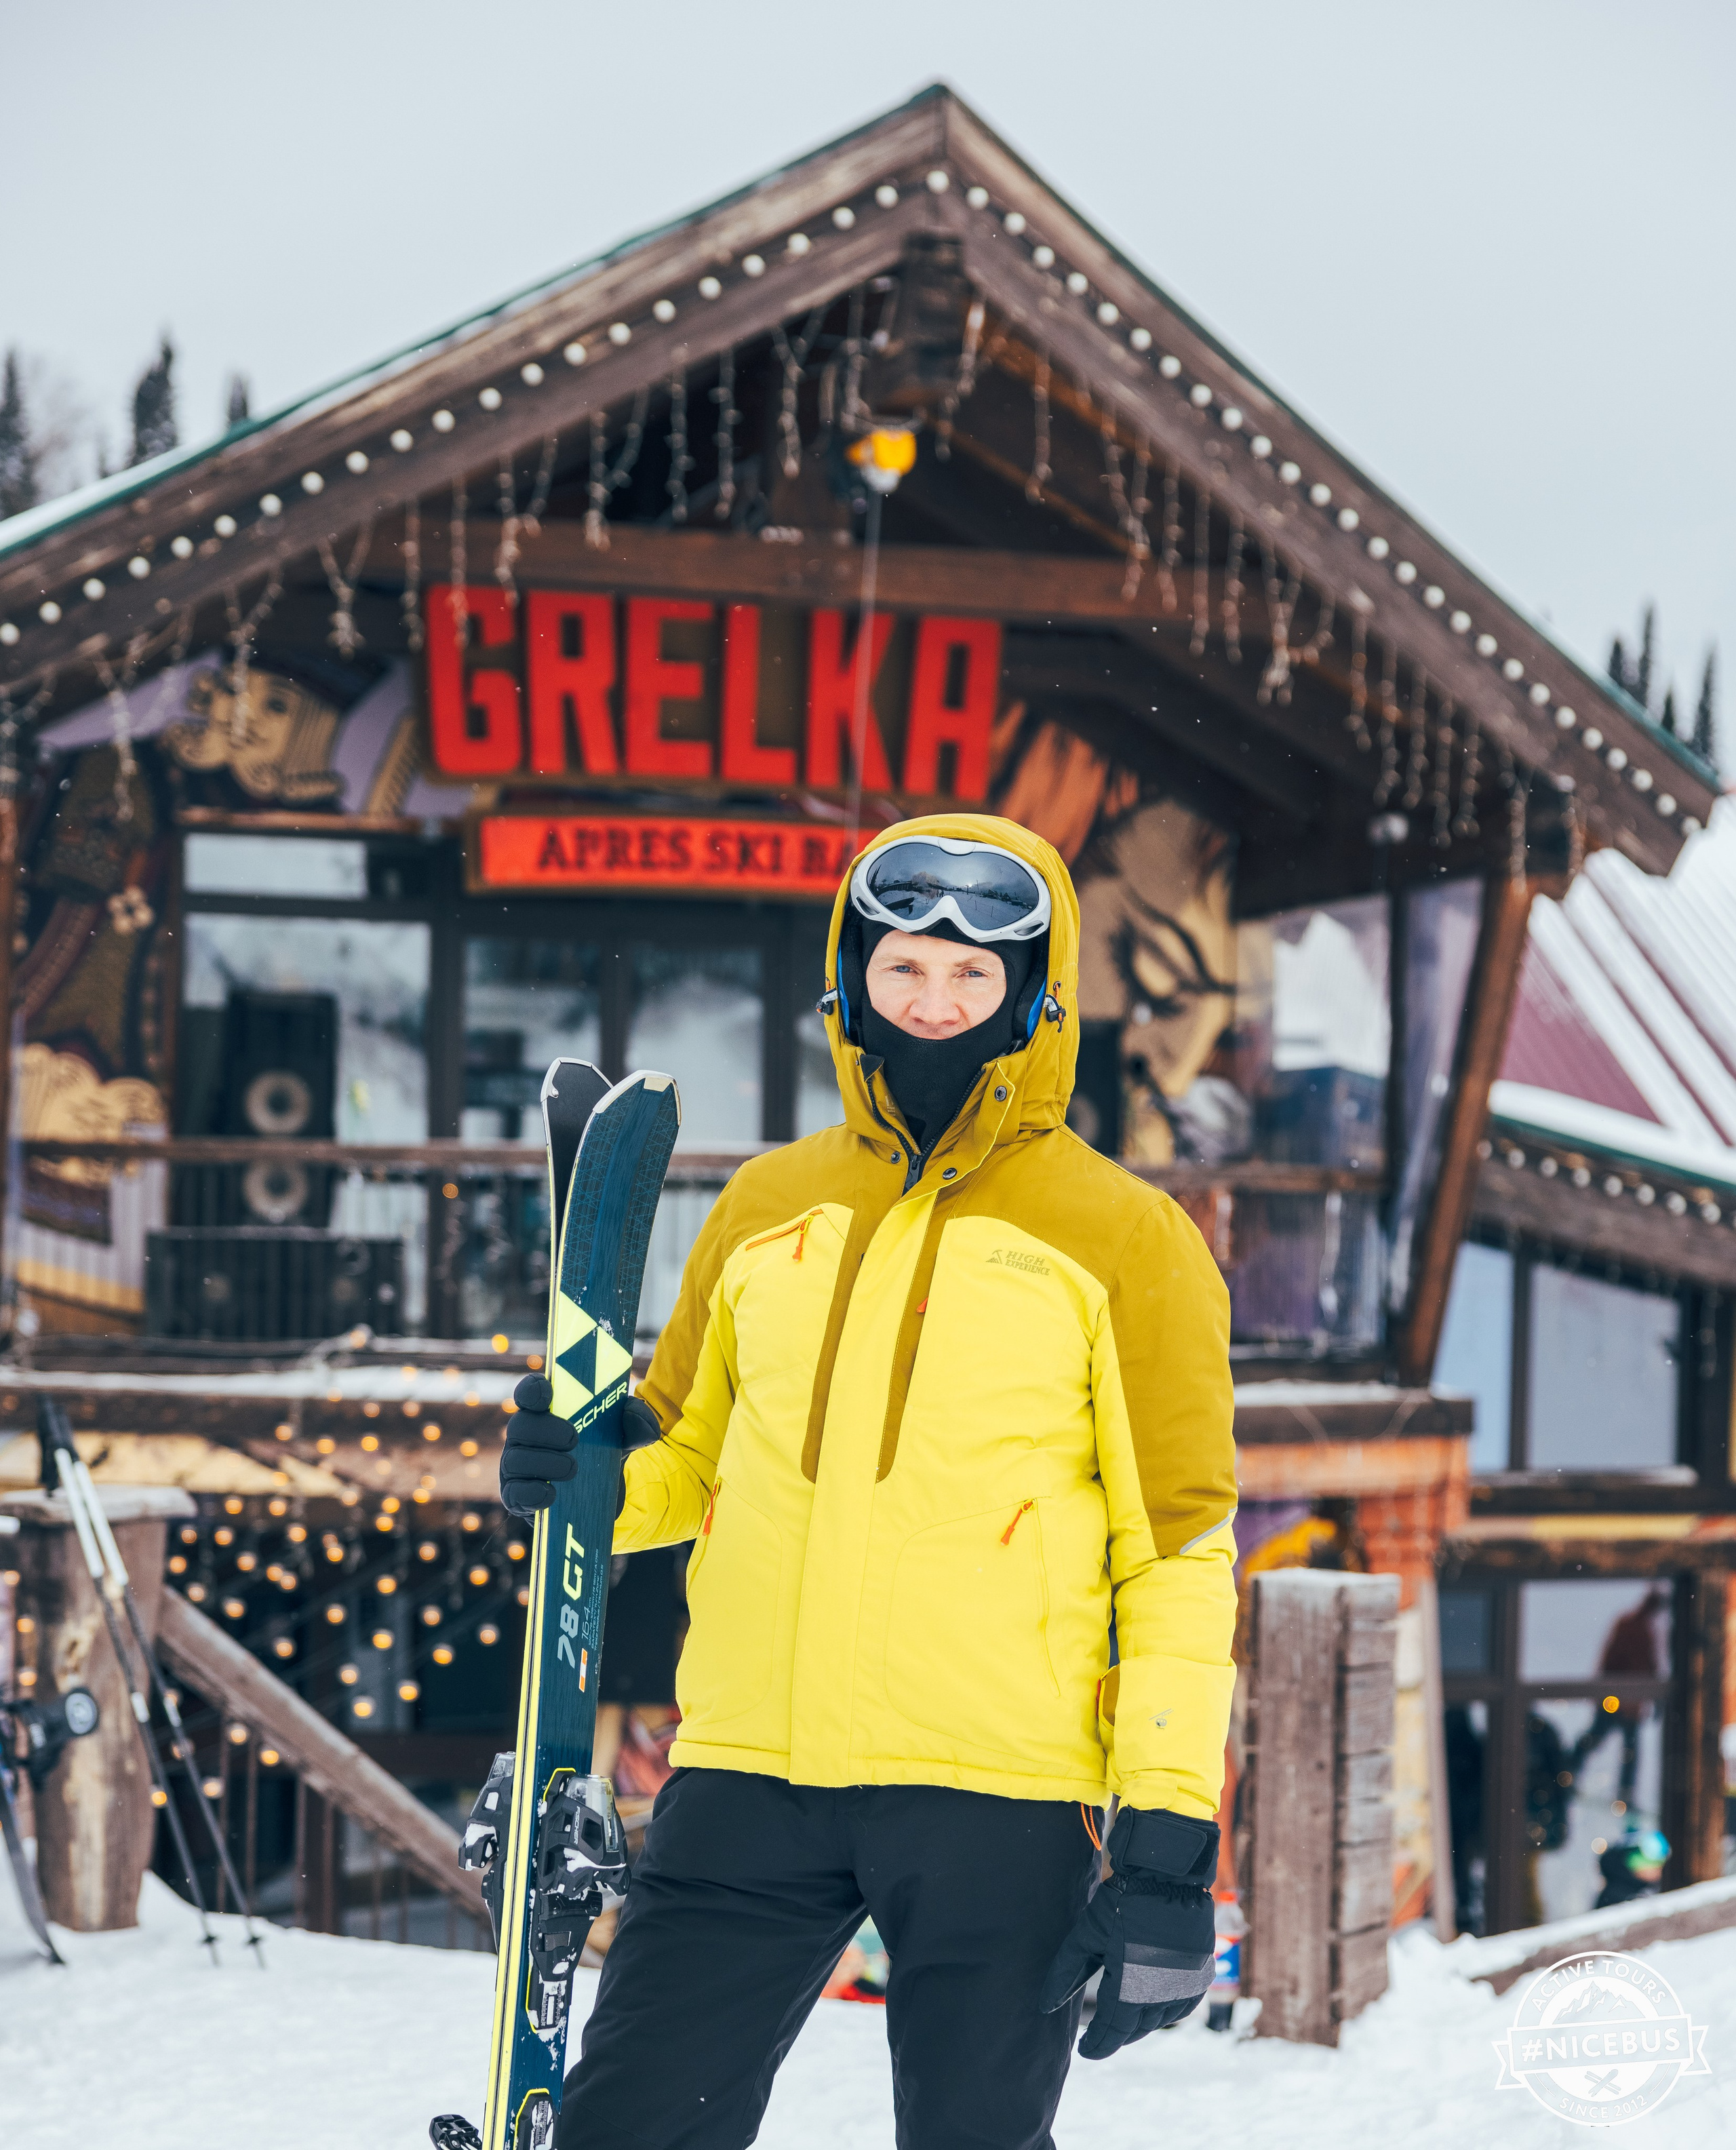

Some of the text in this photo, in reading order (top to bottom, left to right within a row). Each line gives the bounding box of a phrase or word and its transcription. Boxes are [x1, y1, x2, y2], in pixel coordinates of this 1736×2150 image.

[426, 583, 1002, 802] GRELKA
[538, 826, 854, 877] APRES SKI BA
[1005, 1259, 1050, 1276] EXPERIENCE
[1006, 1251, 1046, 1266] HIGH
[573, 1381, 627, 1434] SCHER
[557, 1522, 585, 1669] 78 GT
[581, 1606, 591, 1640] 164
